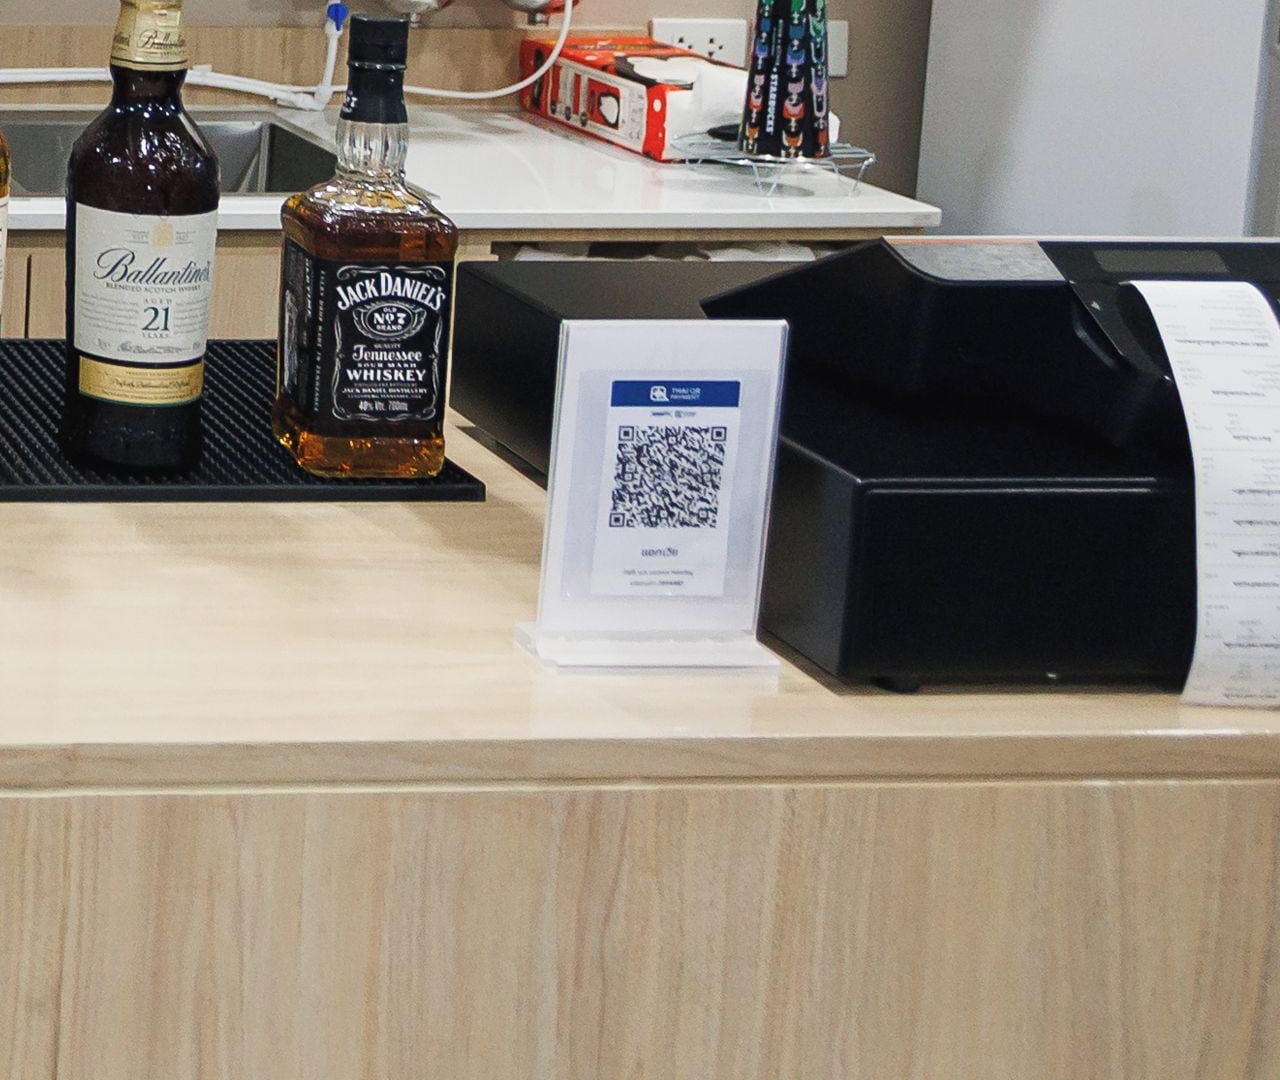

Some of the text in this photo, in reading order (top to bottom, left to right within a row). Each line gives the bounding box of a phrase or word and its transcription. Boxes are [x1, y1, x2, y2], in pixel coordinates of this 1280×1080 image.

[765, 74, 779, 133] STARBUCKS
[105, 282, 142, 293] BLENDED
[144, 285, 177, 294] SCOTCH
[336, 272, 446, 311] JACK DANIEL'S
[142, 306, 170, 331] 21
[352, 344, 423, 361] Tennessee
[346, 369, 426, 381] WHISKEY
